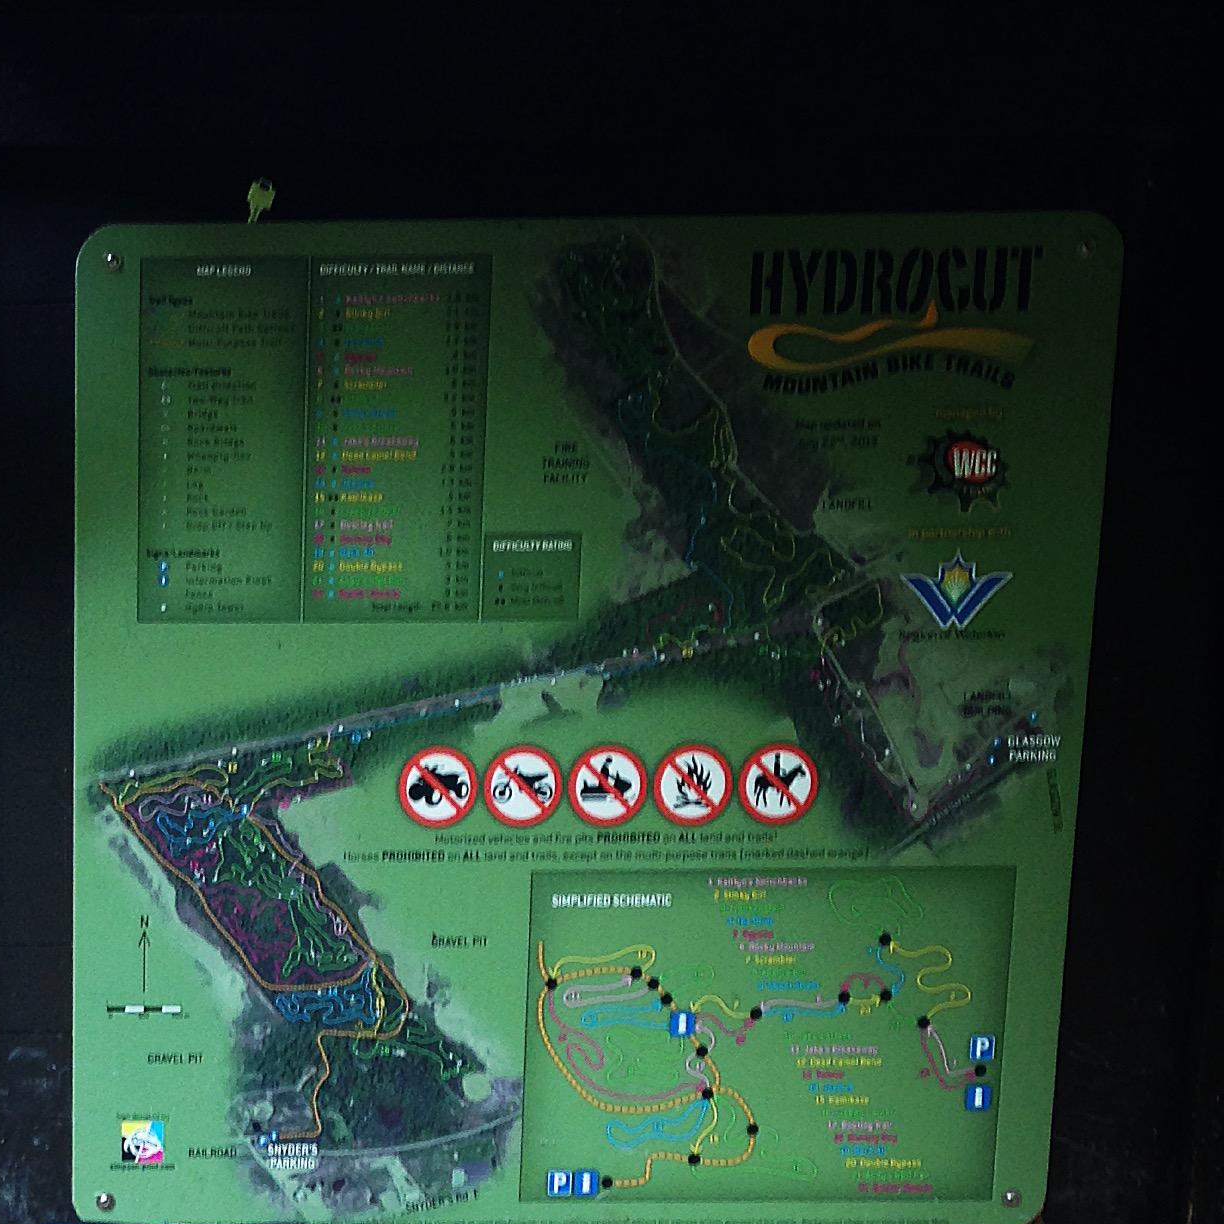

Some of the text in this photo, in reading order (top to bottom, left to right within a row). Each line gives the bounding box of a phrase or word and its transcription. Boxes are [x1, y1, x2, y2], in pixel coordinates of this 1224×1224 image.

[749, 245, 1043, 316] HYDROCUT
[762, 351, 1015, 394] MOUNTAIN BIKE TRAILS
[953, 448, 998, 480] WCC
[1007, 734, 1061, 749] GLASGOW
[1008, 749, 1057, 763] PARKING
[381, 849, 446, 863] PROHIBITED
[551, 892, 673, 910] SIMPLIFIED SCHEMATIC
[188, 1147, 238, 1159] RAILROAD
[268, 1157, 316, 1170] PARKING
